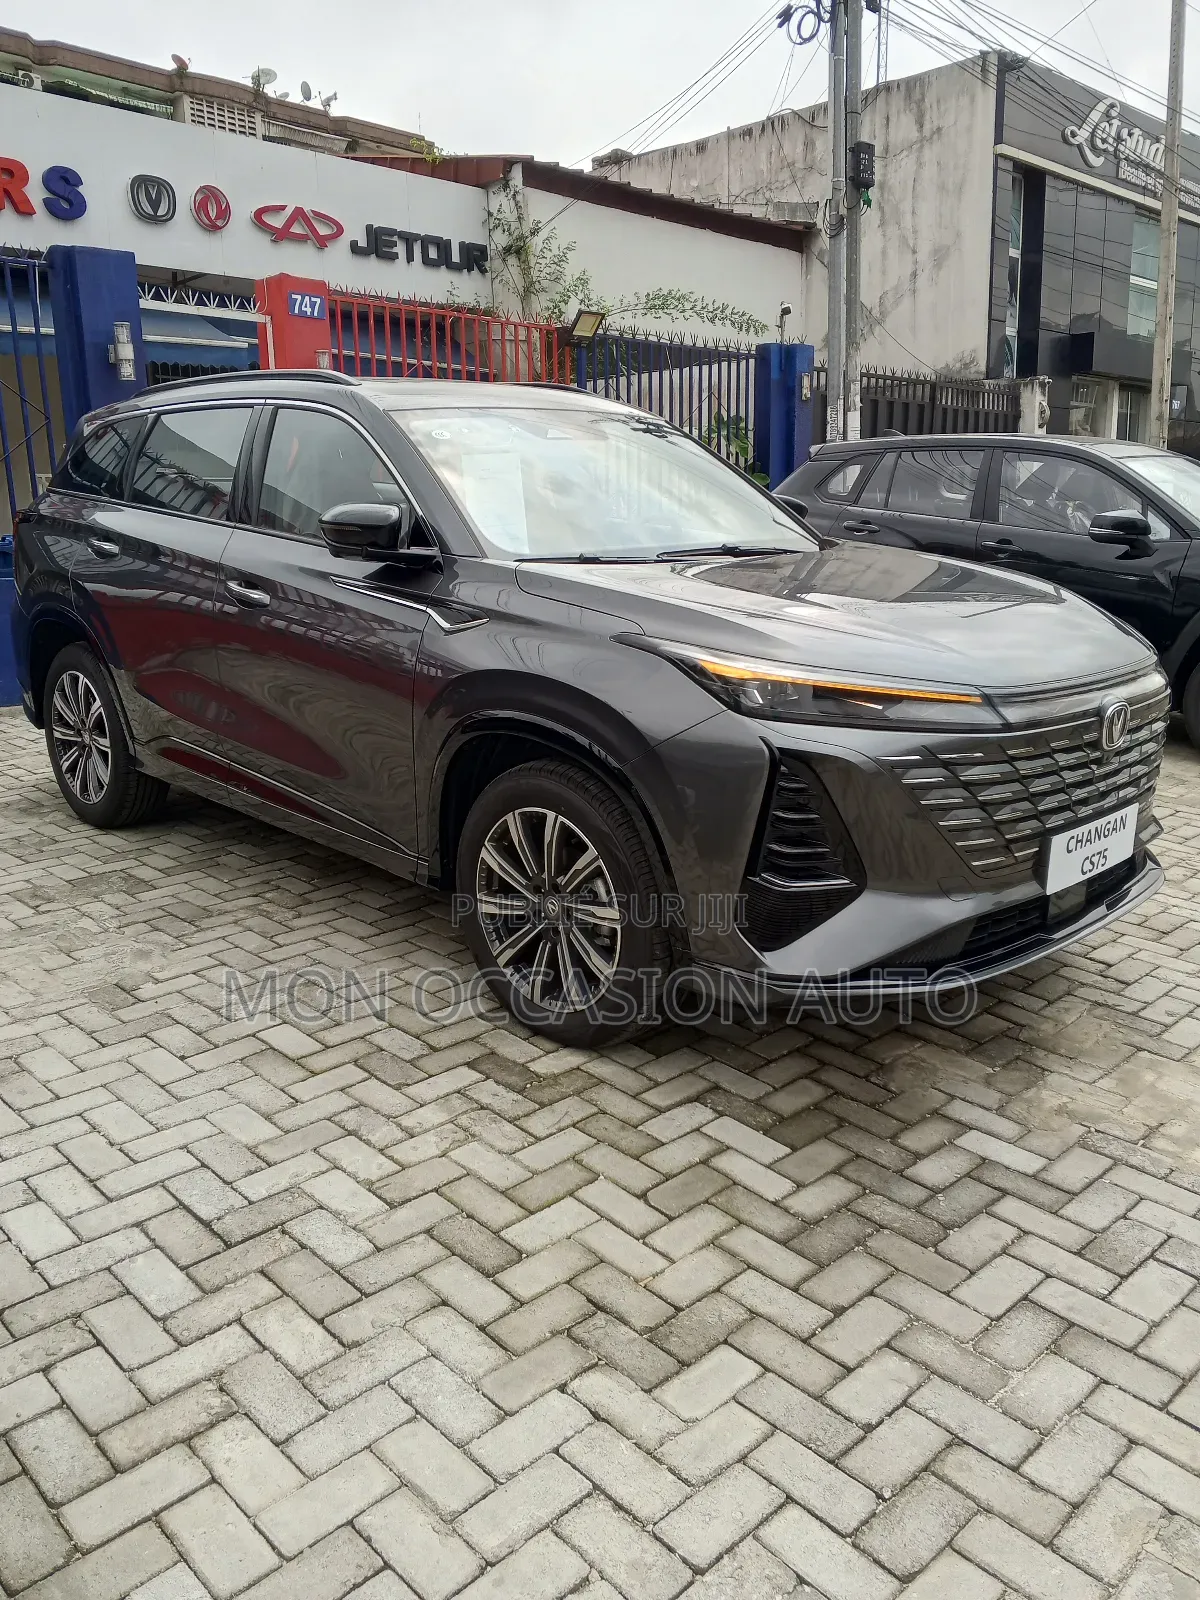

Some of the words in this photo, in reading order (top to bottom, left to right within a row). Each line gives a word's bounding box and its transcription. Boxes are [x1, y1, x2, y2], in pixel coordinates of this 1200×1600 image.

[0, 156, 87, 220] RS
[350, 223, 489, 274] JETOUR
[291, 293, 321, 317] 747
[1066, 813, 1128, 854] CHANGAN
[1080, 847, 1109, 876] CS75
